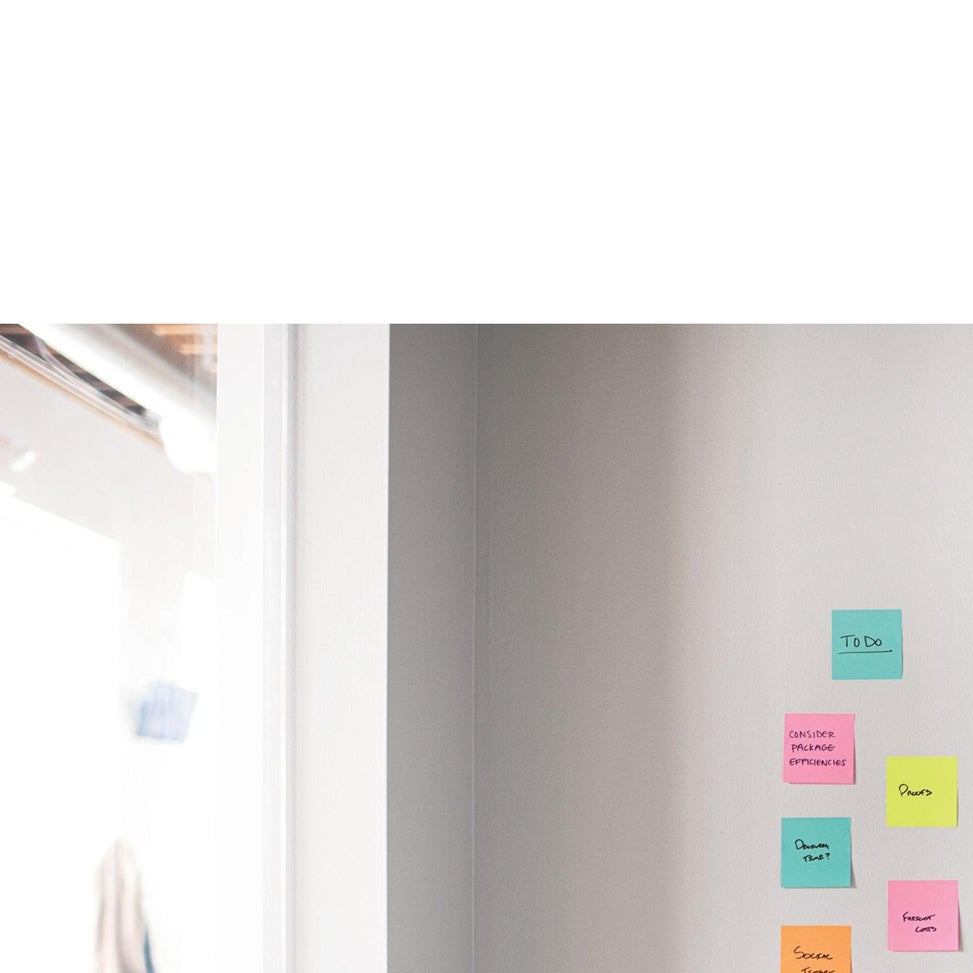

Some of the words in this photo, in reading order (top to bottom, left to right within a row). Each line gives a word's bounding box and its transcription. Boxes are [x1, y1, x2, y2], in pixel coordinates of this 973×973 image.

[788, 729, 836, 739] CONSIDER
[791, 743, 836, 753] PACKAGE
[788, 757, 847, 767] EFFICIENCIES
